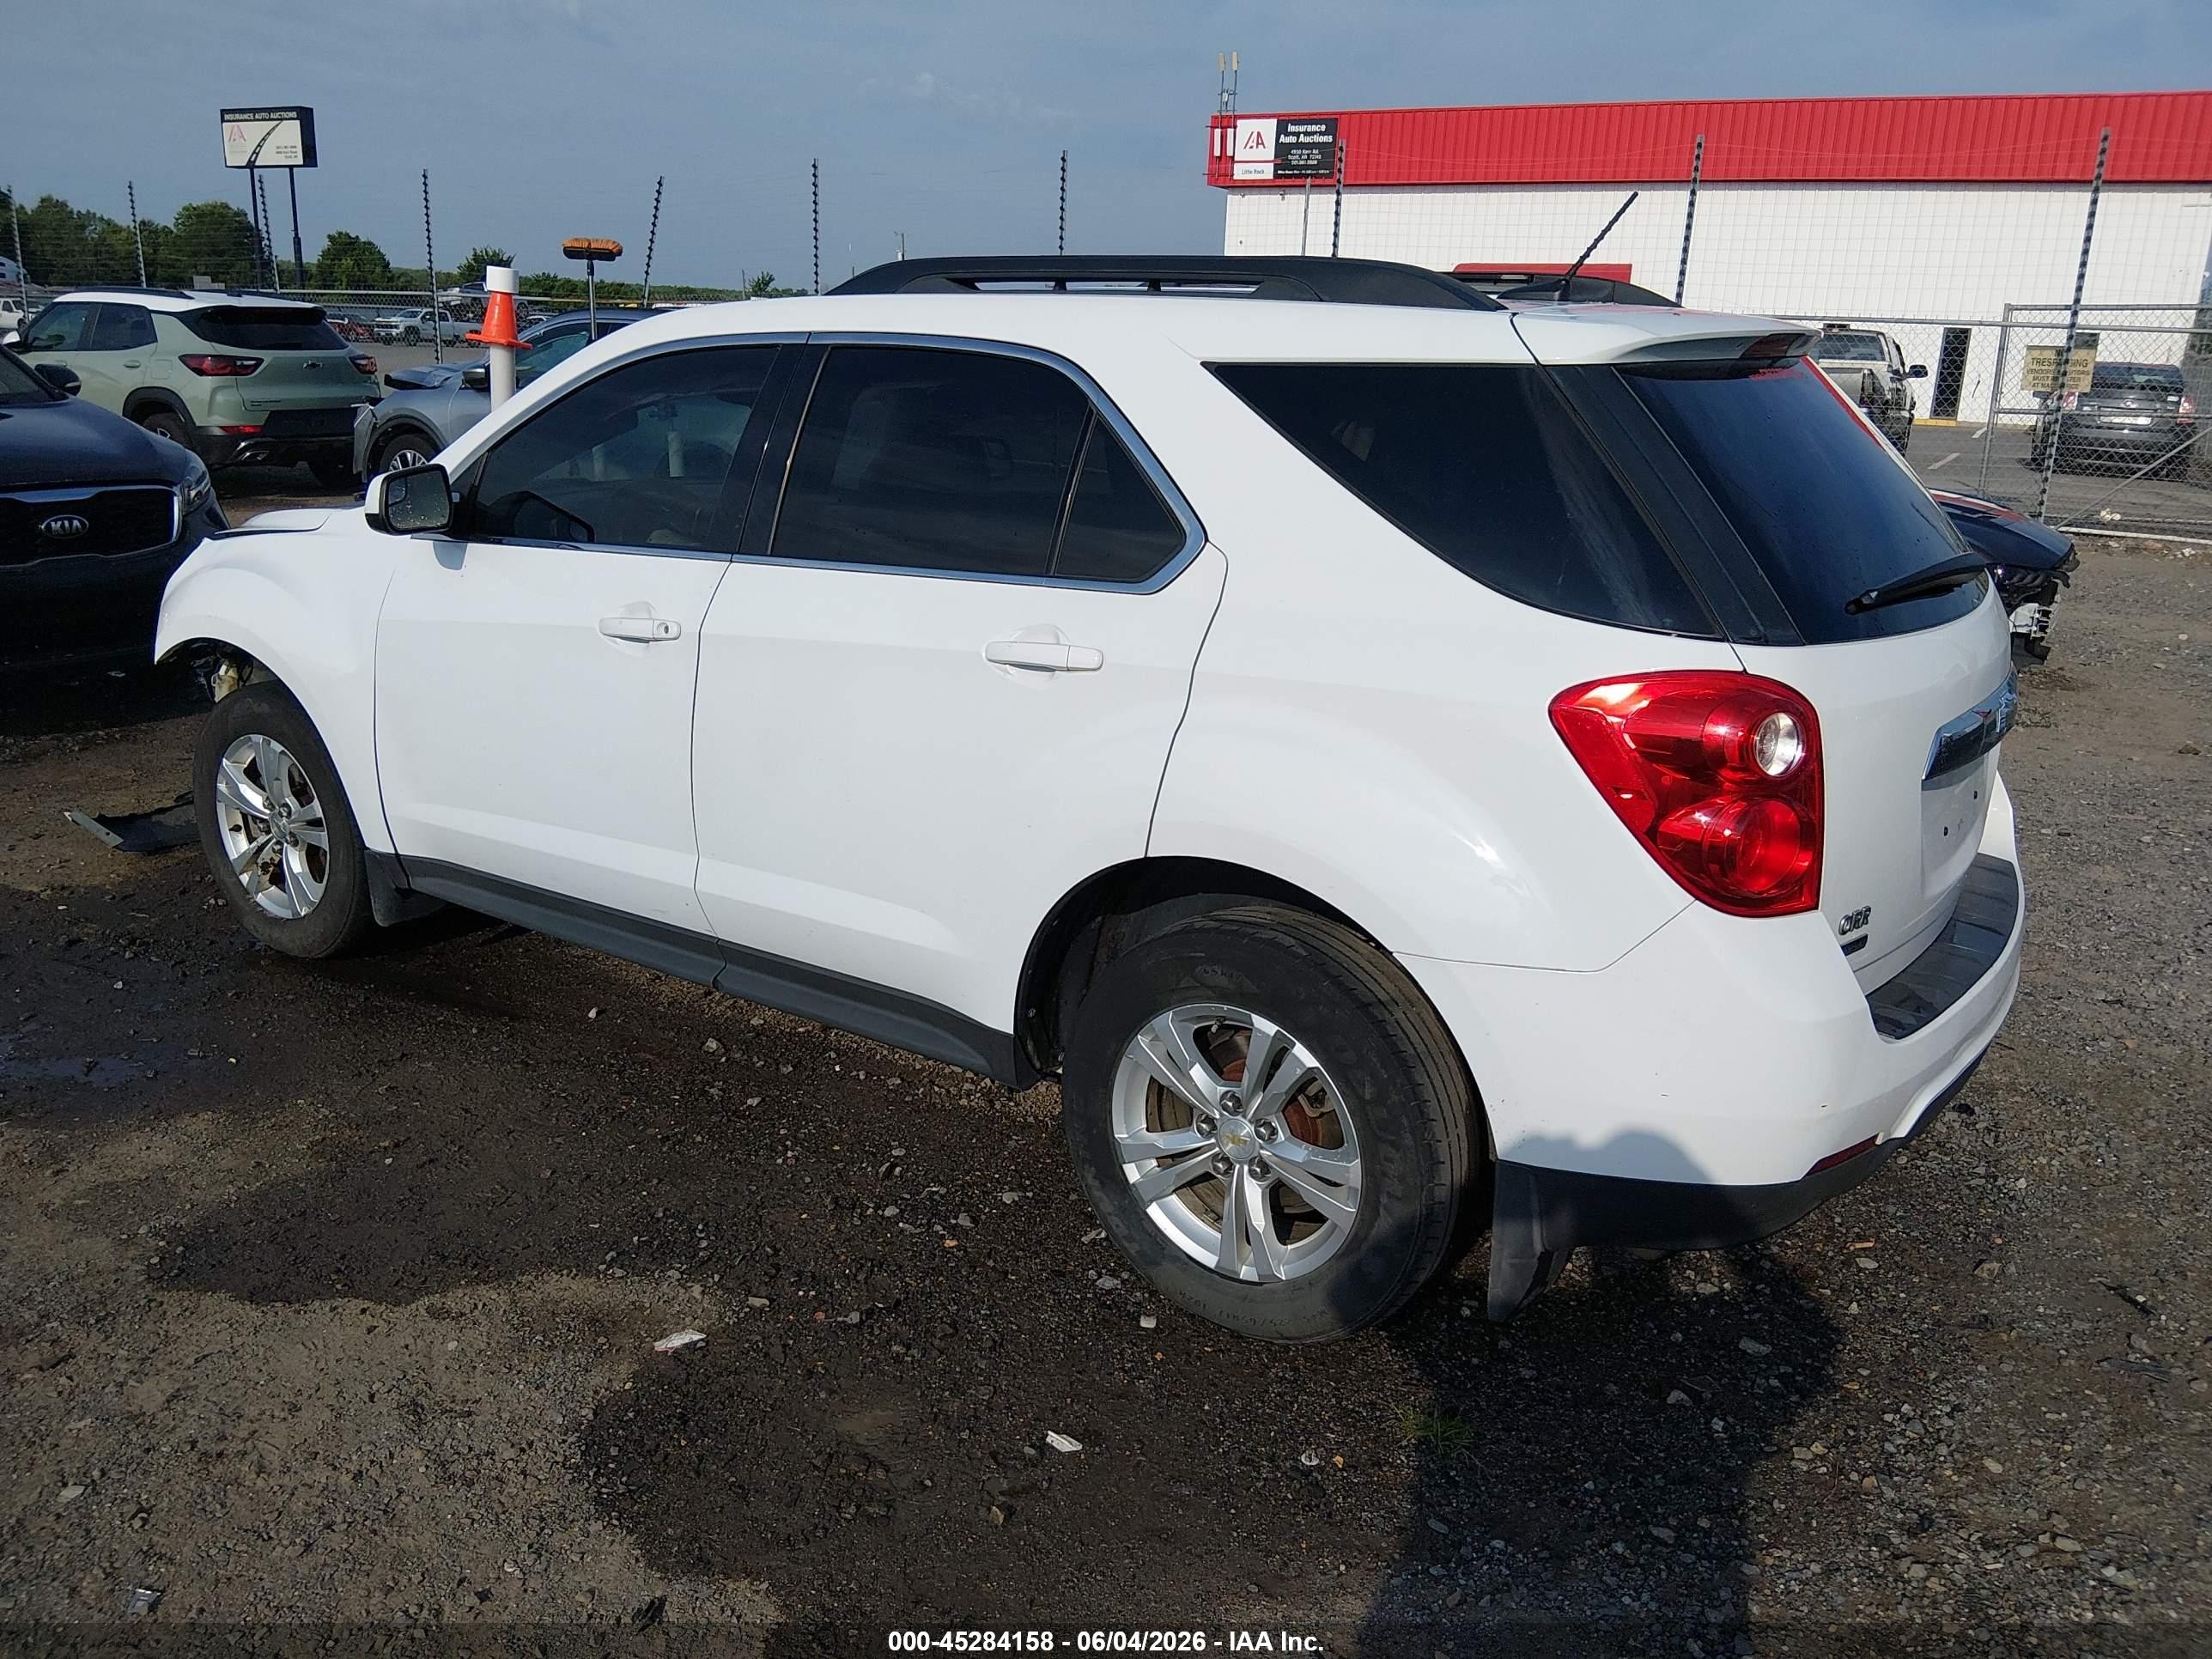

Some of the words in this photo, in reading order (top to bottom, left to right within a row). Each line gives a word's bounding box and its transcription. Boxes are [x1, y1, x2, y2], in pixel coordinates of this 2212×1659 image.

[1287, 123, 1326, 132] Insurance
[1279, 134, 1297, 143] Auto
[1298, 133, 1333, 143] Auctions
[50, 520, 83, 535] KIA
